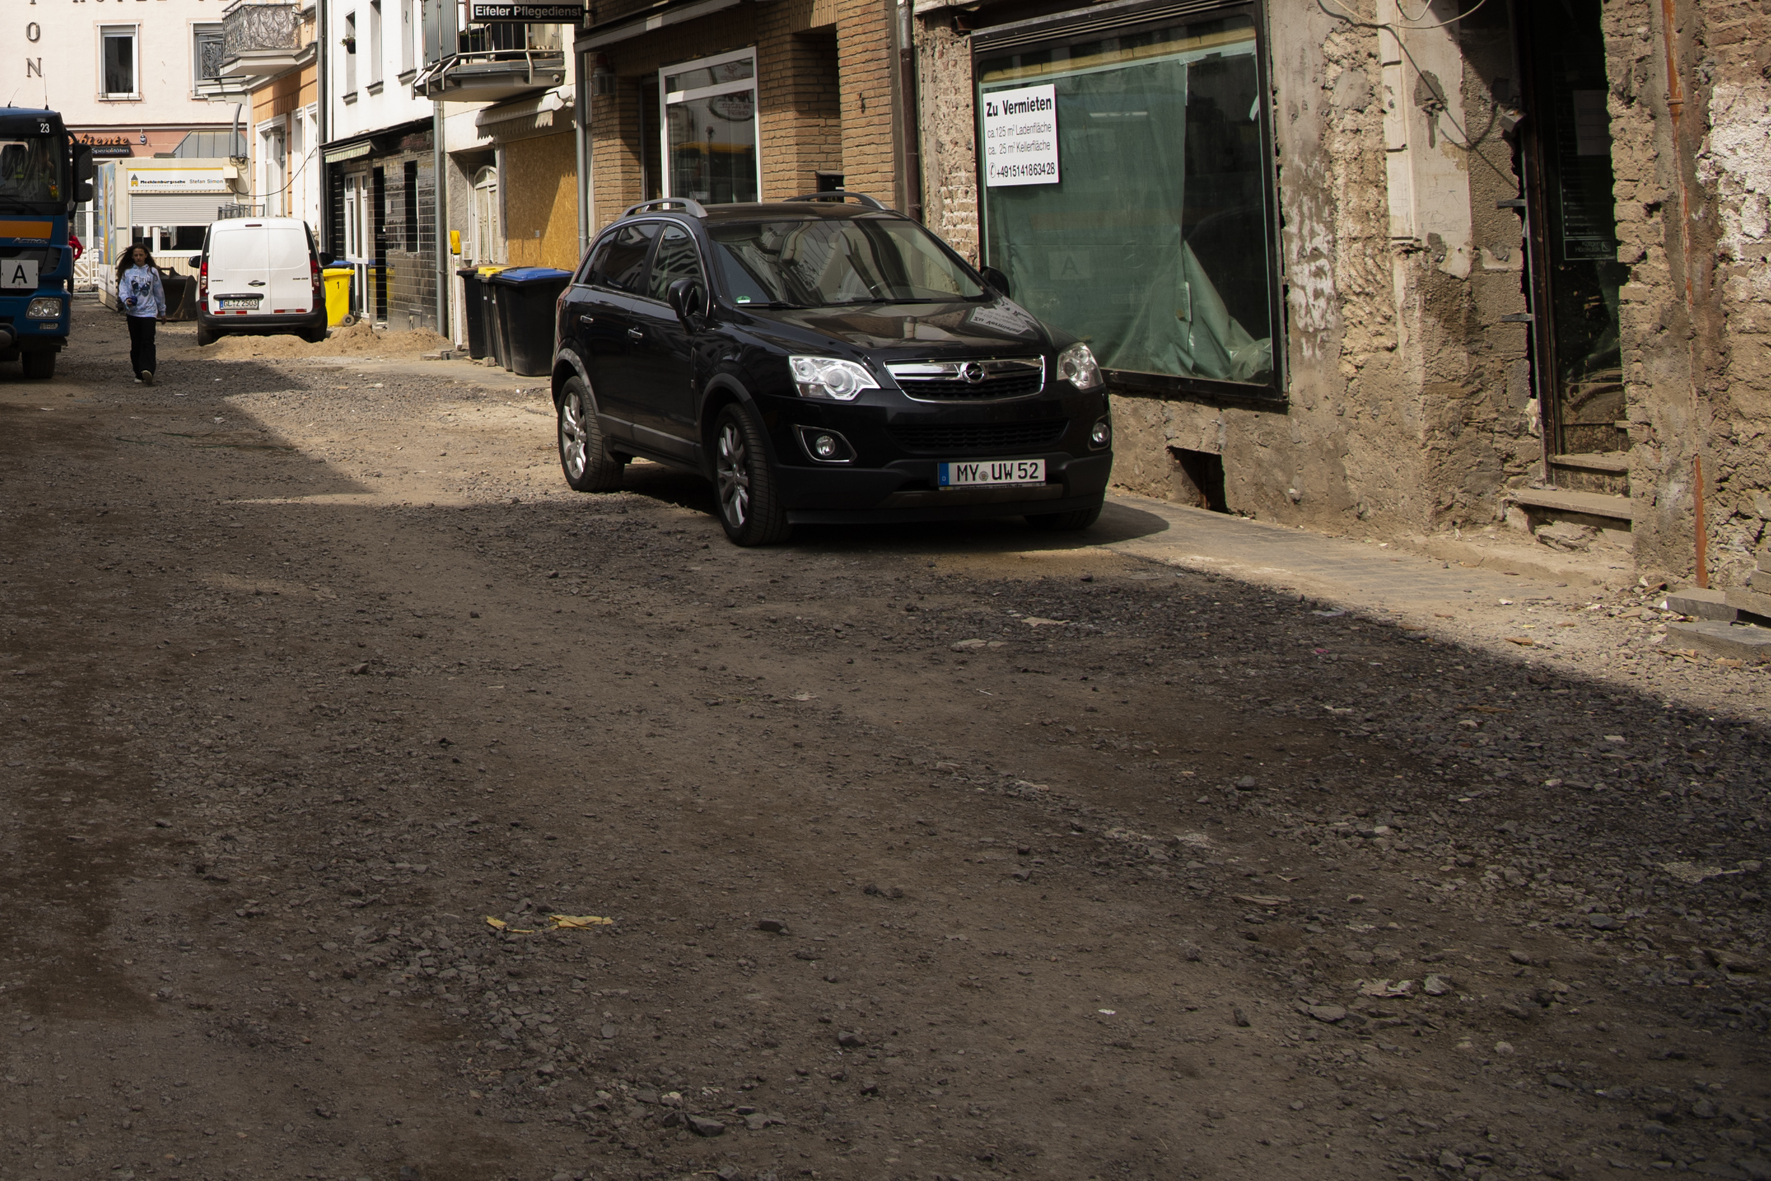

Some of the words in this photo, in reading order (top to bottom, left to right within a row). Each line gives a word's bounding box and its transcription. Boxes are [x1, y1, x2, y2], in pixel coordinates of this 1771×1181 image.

[475, 5, 511, 17] Eifeler
[513, 5, 582, 19] Pflegedienst
[986, 102, 998, 117] Zu
[1002, 96, 1052, 115] Vermieten
[40, 123, 50, 134] 23
[68, 132, 130, 146] biente
[11, 264, 28, 284] A
[336, 281, 340, 290] 1
[956, 464, 979, 482] MY
[991, 462, 1014, 481] UW
[1017, 462, 1039, 481] 52
